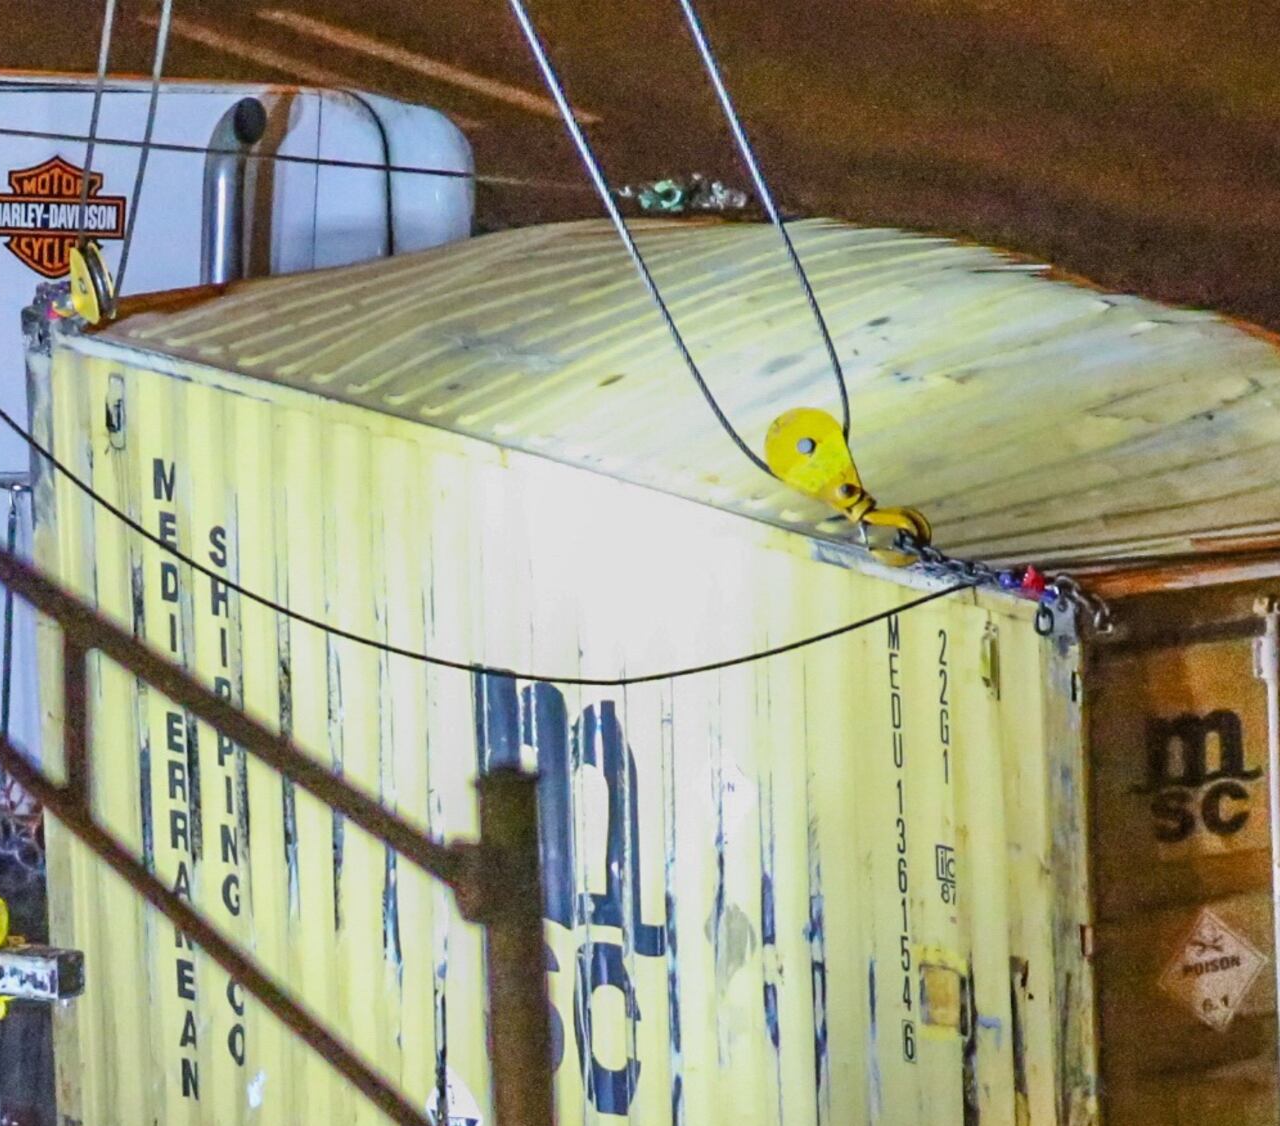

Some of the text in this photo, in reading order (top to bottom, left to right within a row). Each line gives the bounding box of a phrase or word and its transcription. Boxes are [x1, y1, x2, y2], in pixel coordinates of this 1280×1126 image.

[21, 236, 82, 268] CYCLE
[887, 613, 903, 768] MEDU
[938, 629, 950, 785] 22G1
[152, 457, 200, 1101] MEDIERRAEAN
[1182, 954, 1242, 977] POISON
